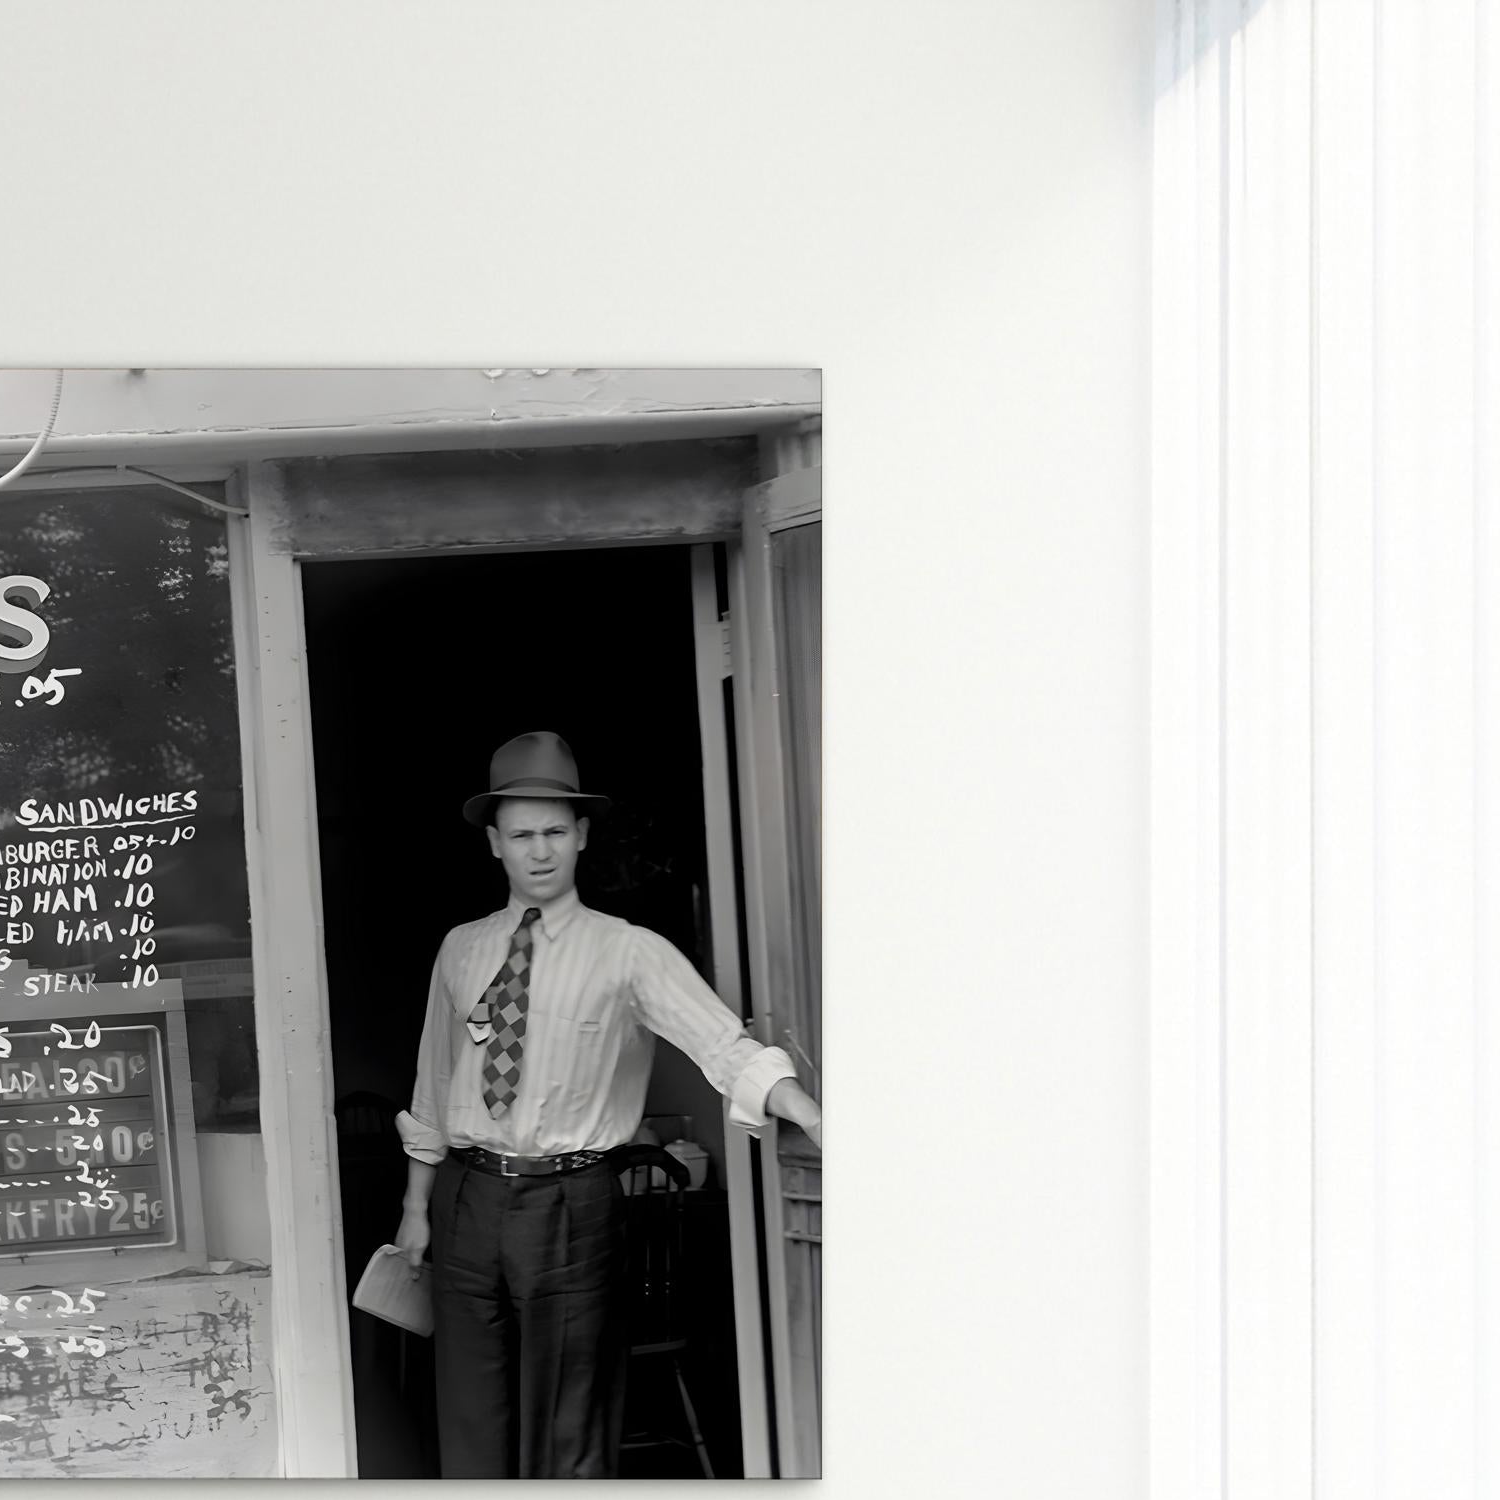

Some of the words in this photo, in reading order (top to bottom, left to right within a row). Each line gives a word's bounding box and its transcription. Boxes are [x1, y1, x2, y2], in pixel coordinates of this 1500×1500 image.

[15, 668, 82, 707] .05
[15, 790, 198, 826] SANDWICHES
[114, 853, 153, 879] .10
[33, 883, 97, 914] HAM
[115, 883, 154, 908] .10
[120, 912, 155, 937] .10
[120, 938, 156, 960] .10
[22, 973, 100, 997] STEAK
[43, 1021, 101, 1055] .20
